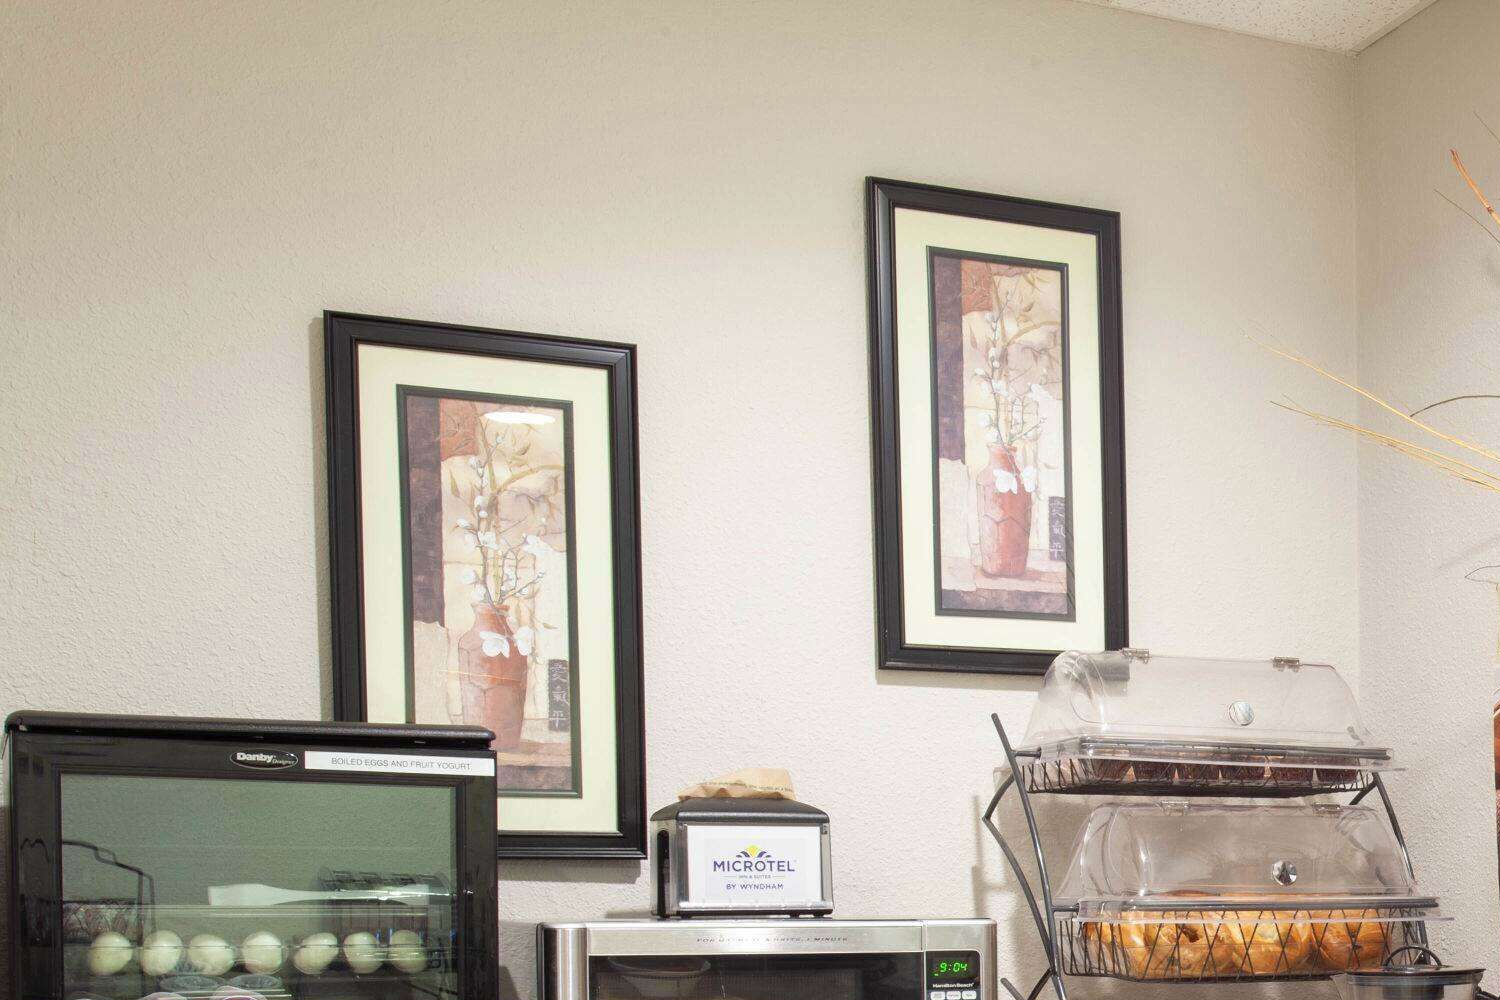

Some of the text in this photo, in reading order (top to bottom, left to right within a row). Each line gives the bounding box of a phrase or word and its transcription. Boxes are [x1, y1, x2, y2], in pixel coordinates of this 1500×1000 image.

[236, 752, 273, 763] Danby
[331, 757, 471, 770] BOILED EGGS AND FRUIT YOGURT
[713, 860, 795, 872] MICROTEL
[940, 962, 968, 972] 9:04
